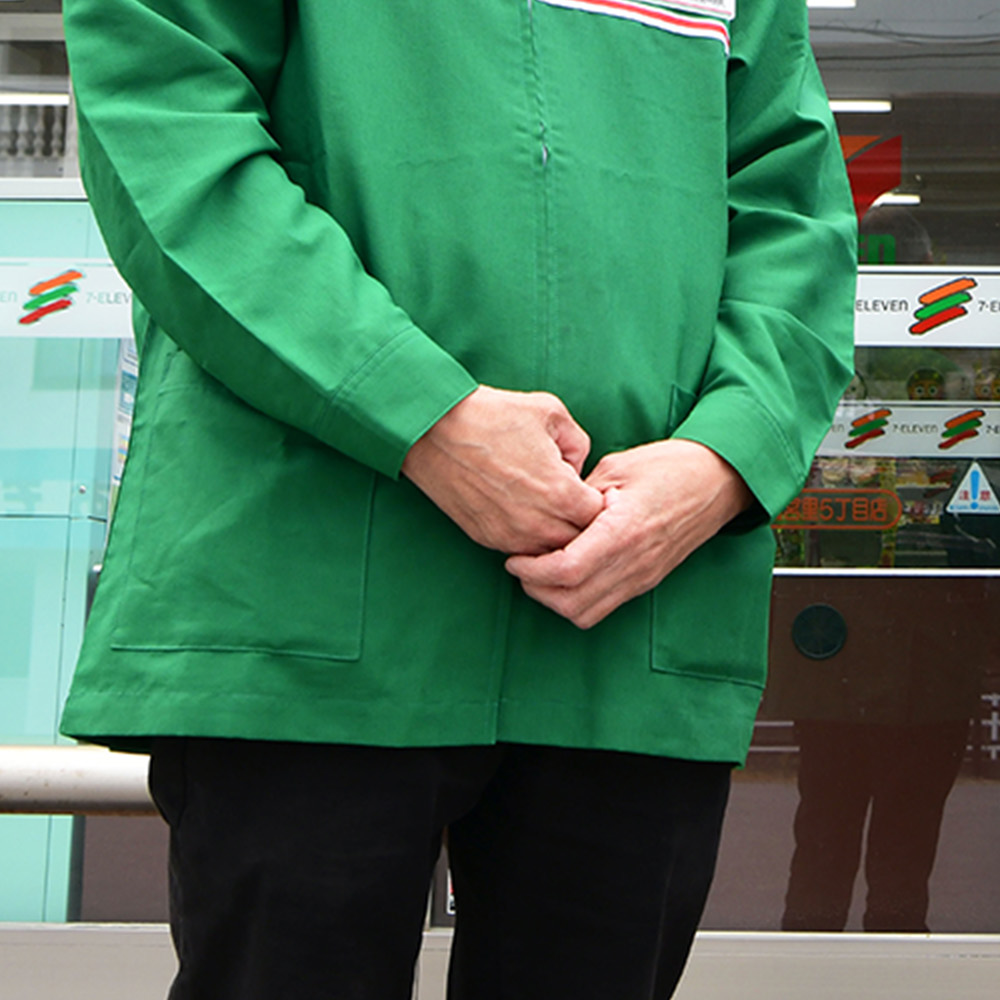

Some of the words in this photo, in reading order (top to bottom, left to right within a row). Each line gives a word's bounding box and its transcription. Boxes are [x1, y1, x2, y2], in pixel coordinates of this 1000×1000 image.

[86, 291, 132, 304] 7-ELEV
[855, 299, 908, 311] ELEVEn
[777, 497, 888, 521] 宮里5丁目店
